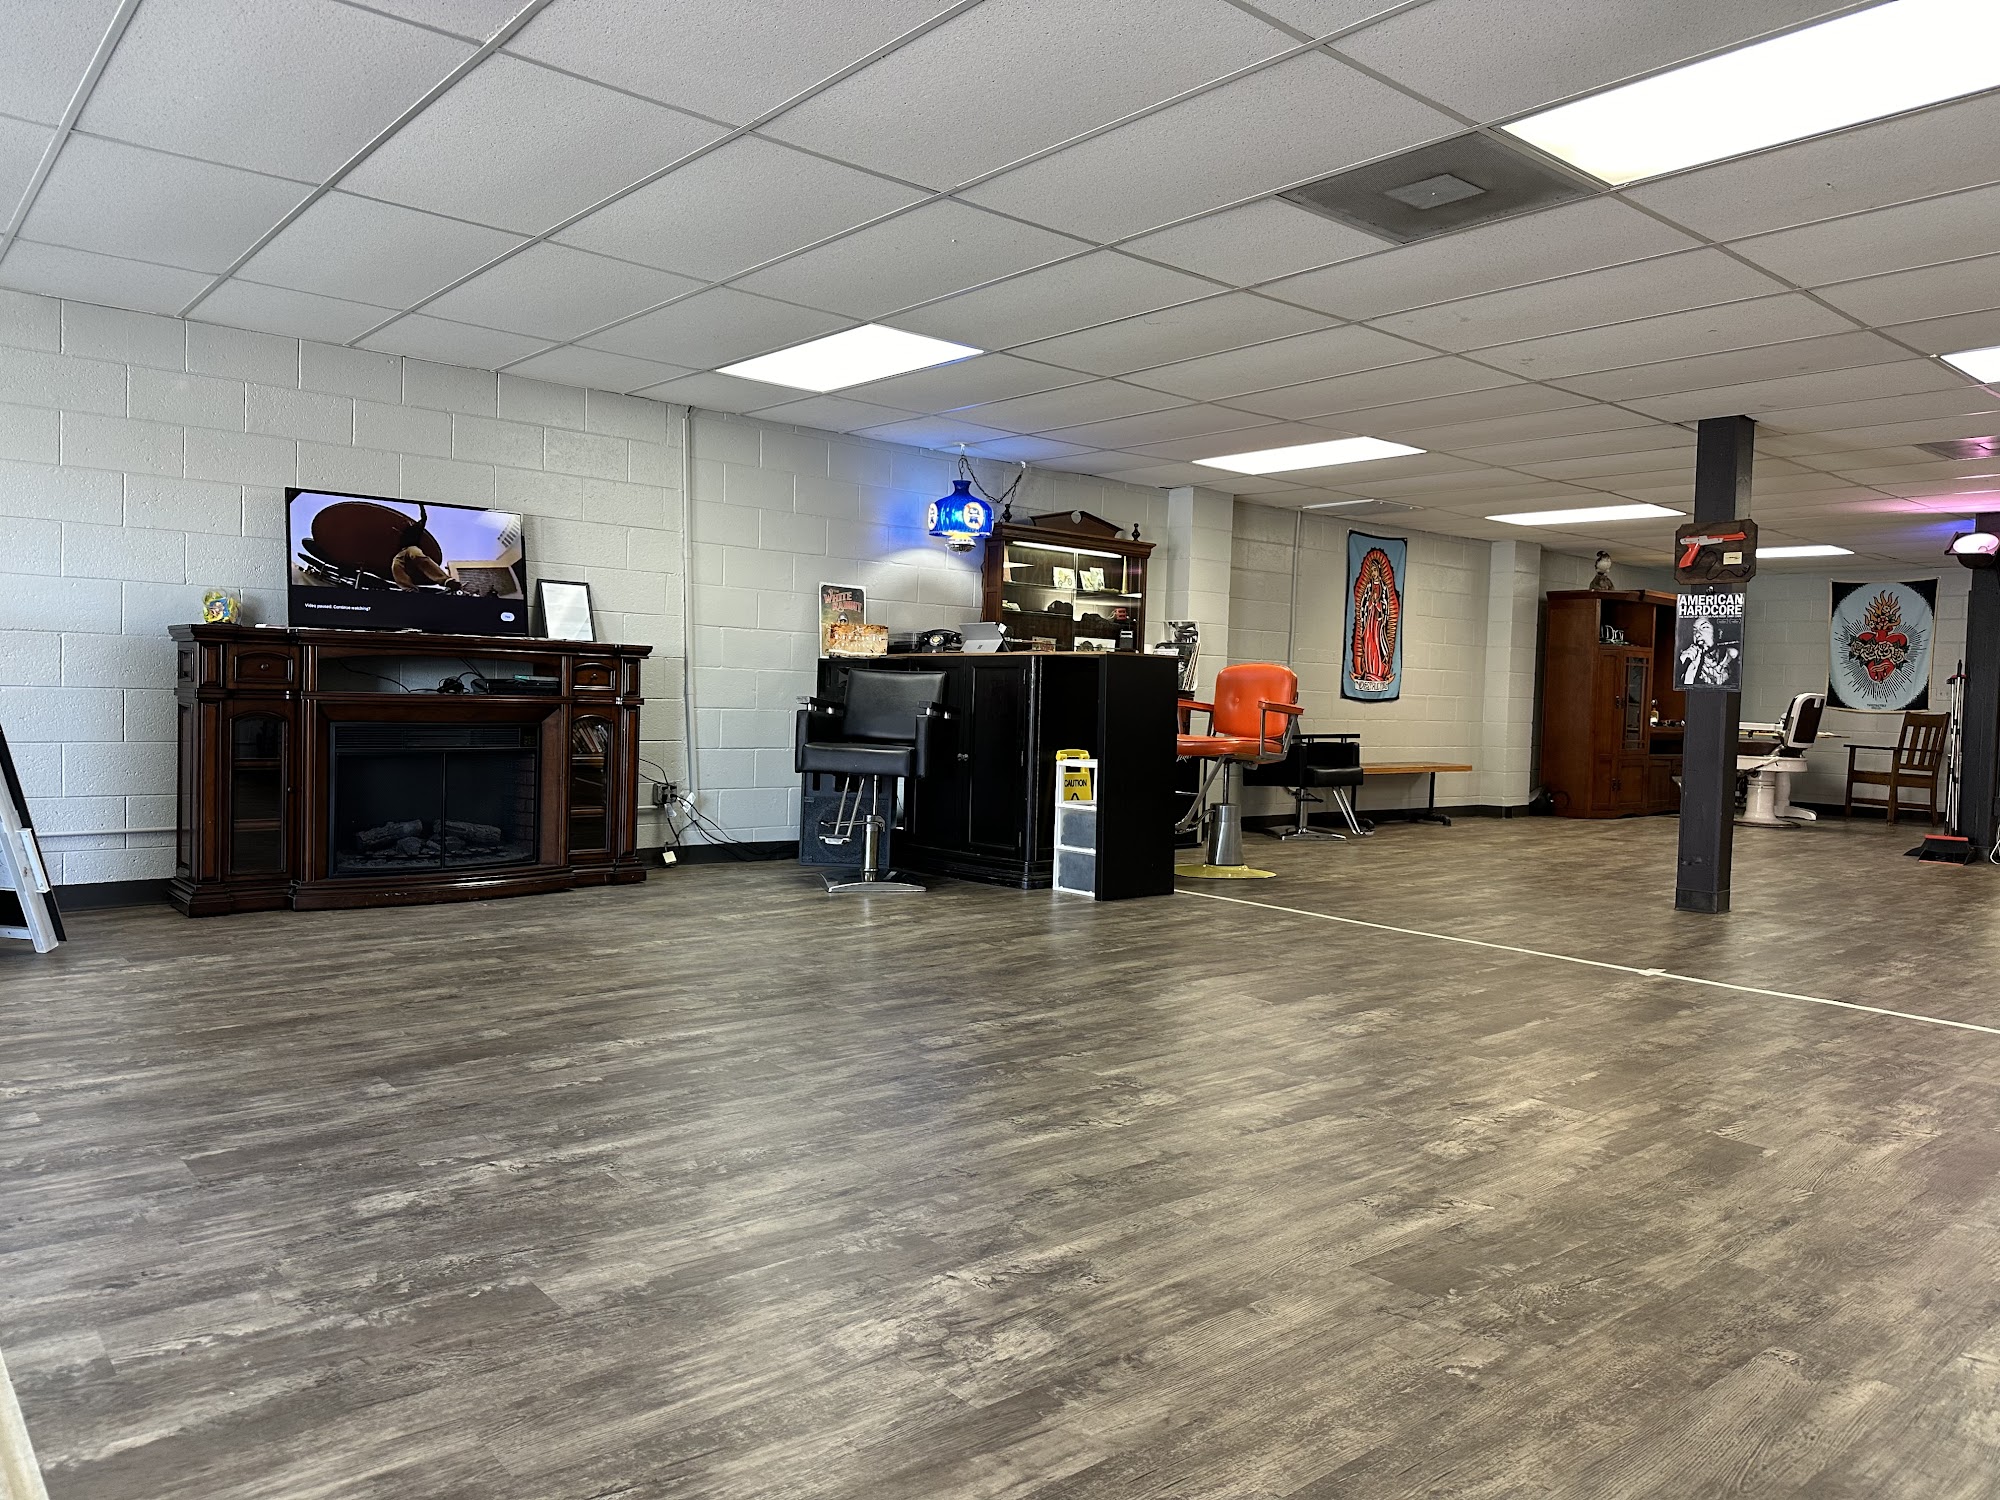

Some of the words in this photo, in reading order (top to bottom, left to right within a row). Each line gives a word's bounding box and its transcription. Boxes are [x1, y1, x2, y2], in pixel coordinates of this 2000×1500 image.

[823, 591, 853, 604] WHITE
[1679, 594, 1743, 605] AMERICAN
[1679, 605, 1743, 616] HARDCORE
[1064, 779, 1087, 788] CAUTION
